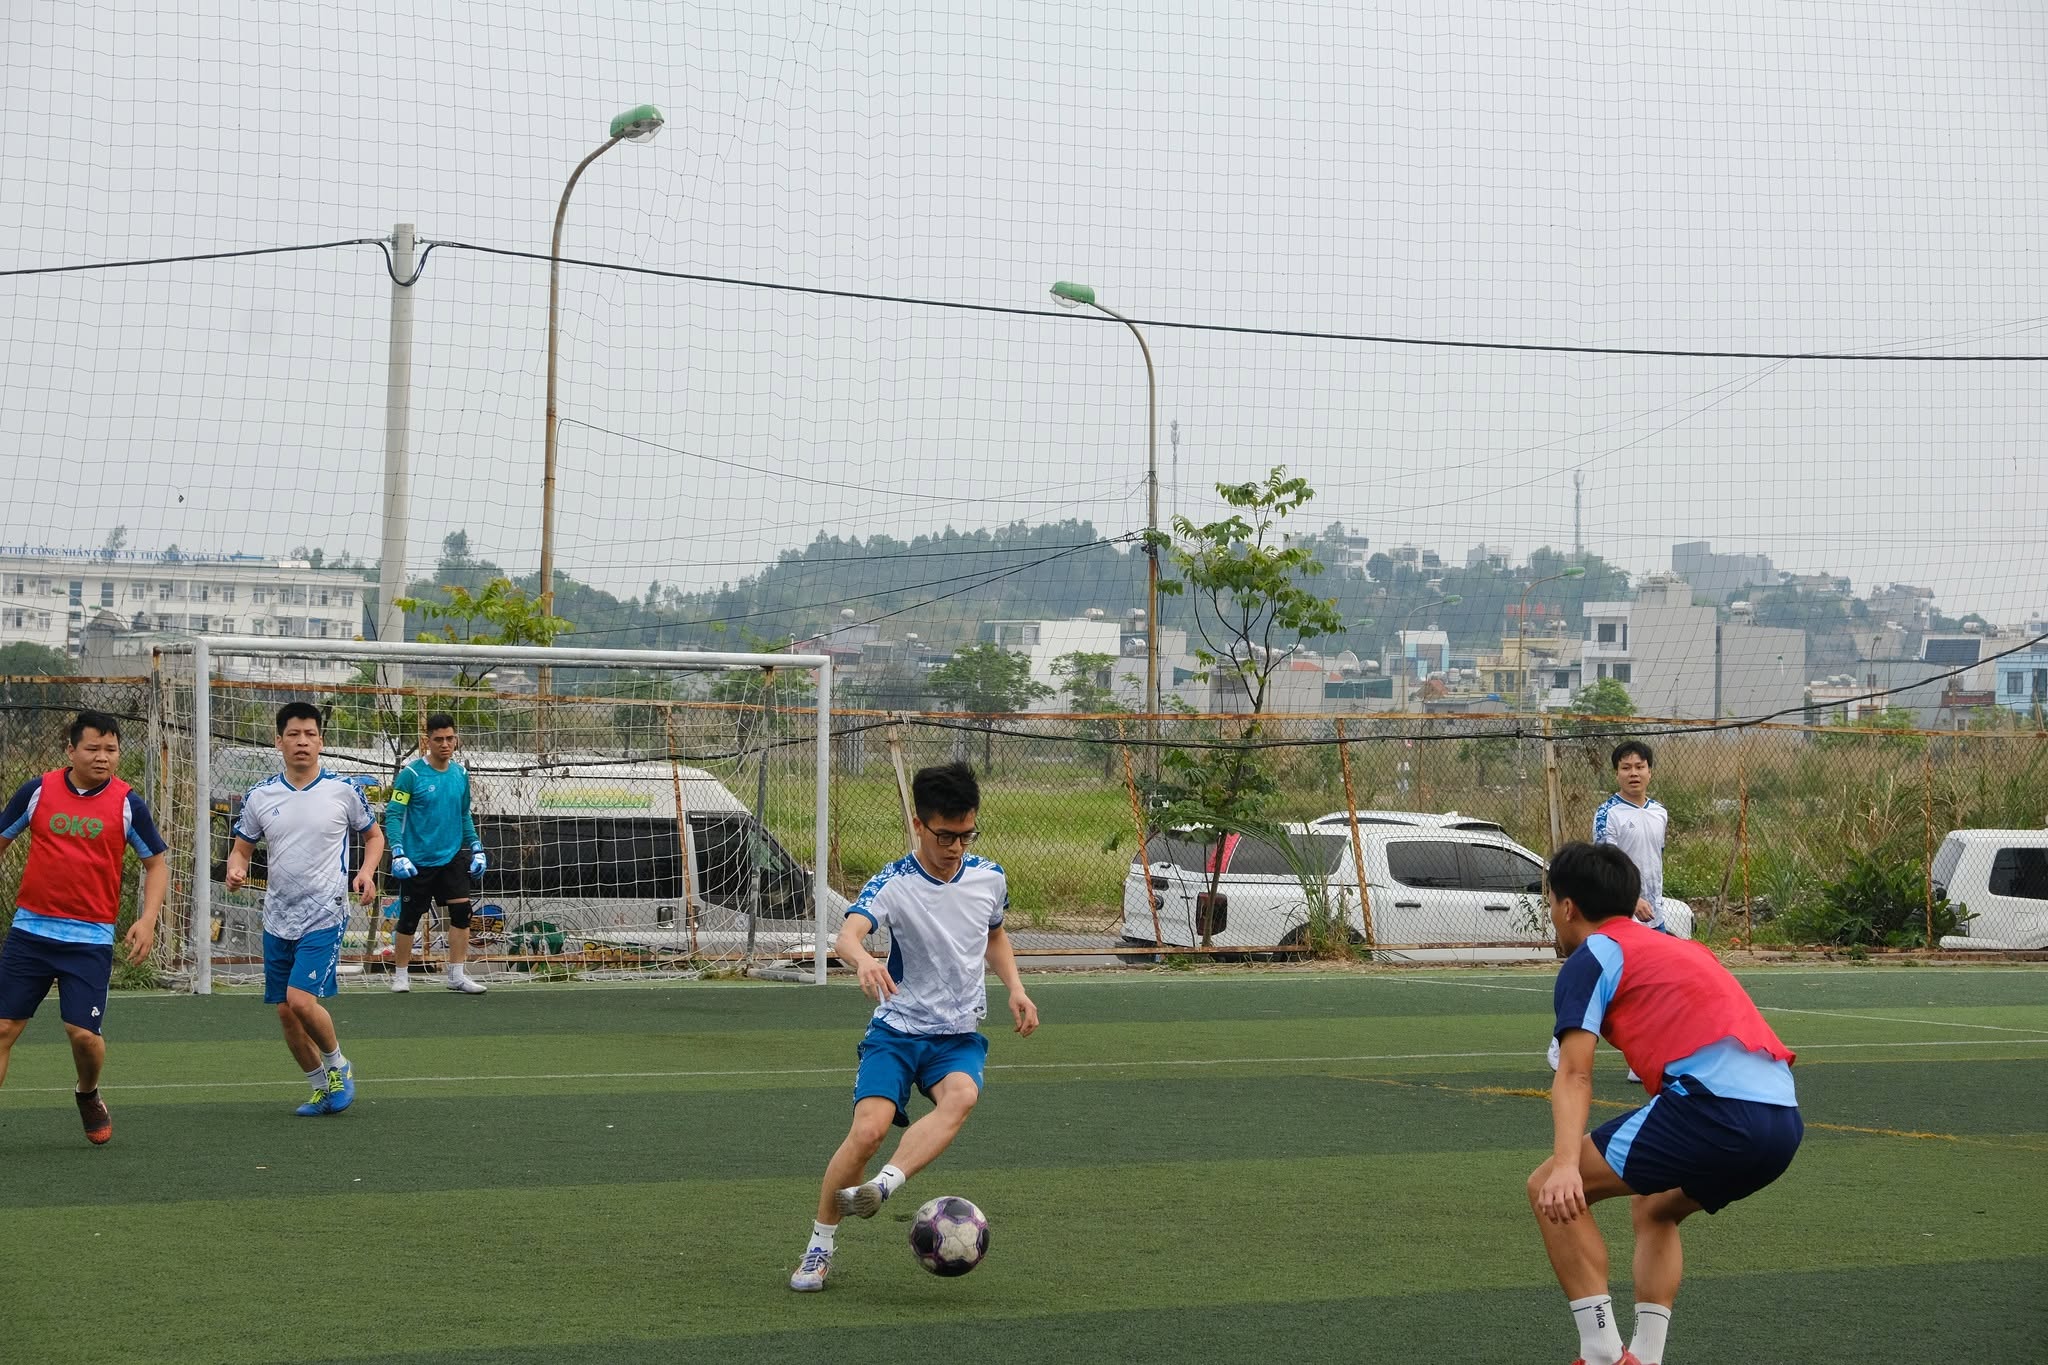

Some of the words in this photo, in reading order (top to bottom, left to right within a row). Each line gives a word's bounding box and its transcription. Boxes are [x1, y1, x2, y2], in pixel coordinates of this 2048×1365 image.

[395, 791, 404, 801] C
[50, 813, 103, 839] OK9
[1594, 1304, 1606, 1329] Wika
